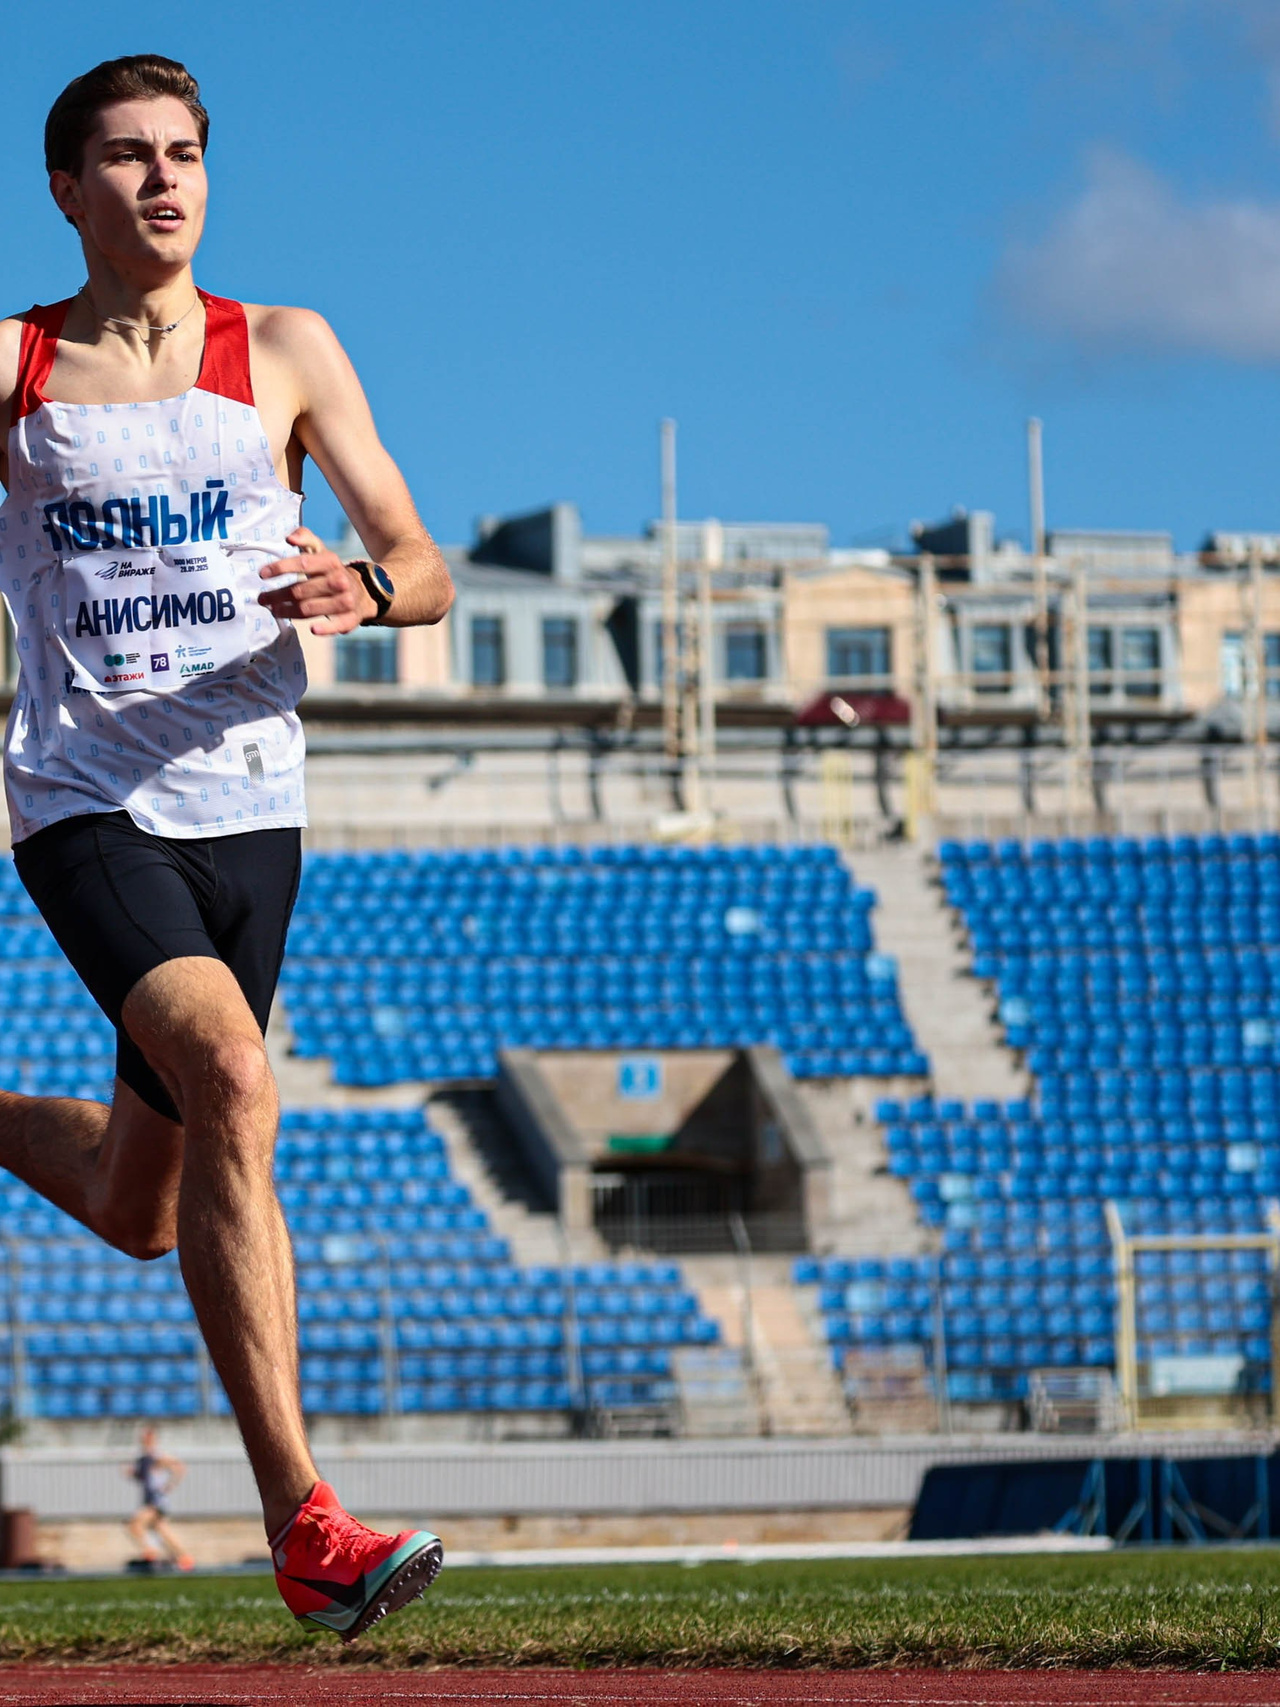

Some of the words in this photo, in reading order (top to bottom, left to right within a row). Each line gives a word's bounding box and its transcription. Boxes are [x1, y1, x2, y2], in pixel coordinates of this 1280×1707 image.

[42, 479, 234, 552] ПОЛНЫЙ
[121, 561, 132, 569] НА
[186, 556, 207, 565] МЕТРОВ
[118, 567, 156, 577] ВИРАЖЕ
[75, 588, 236, 638] АНИСИМОВ
[153, 656, 167, 669] 78
